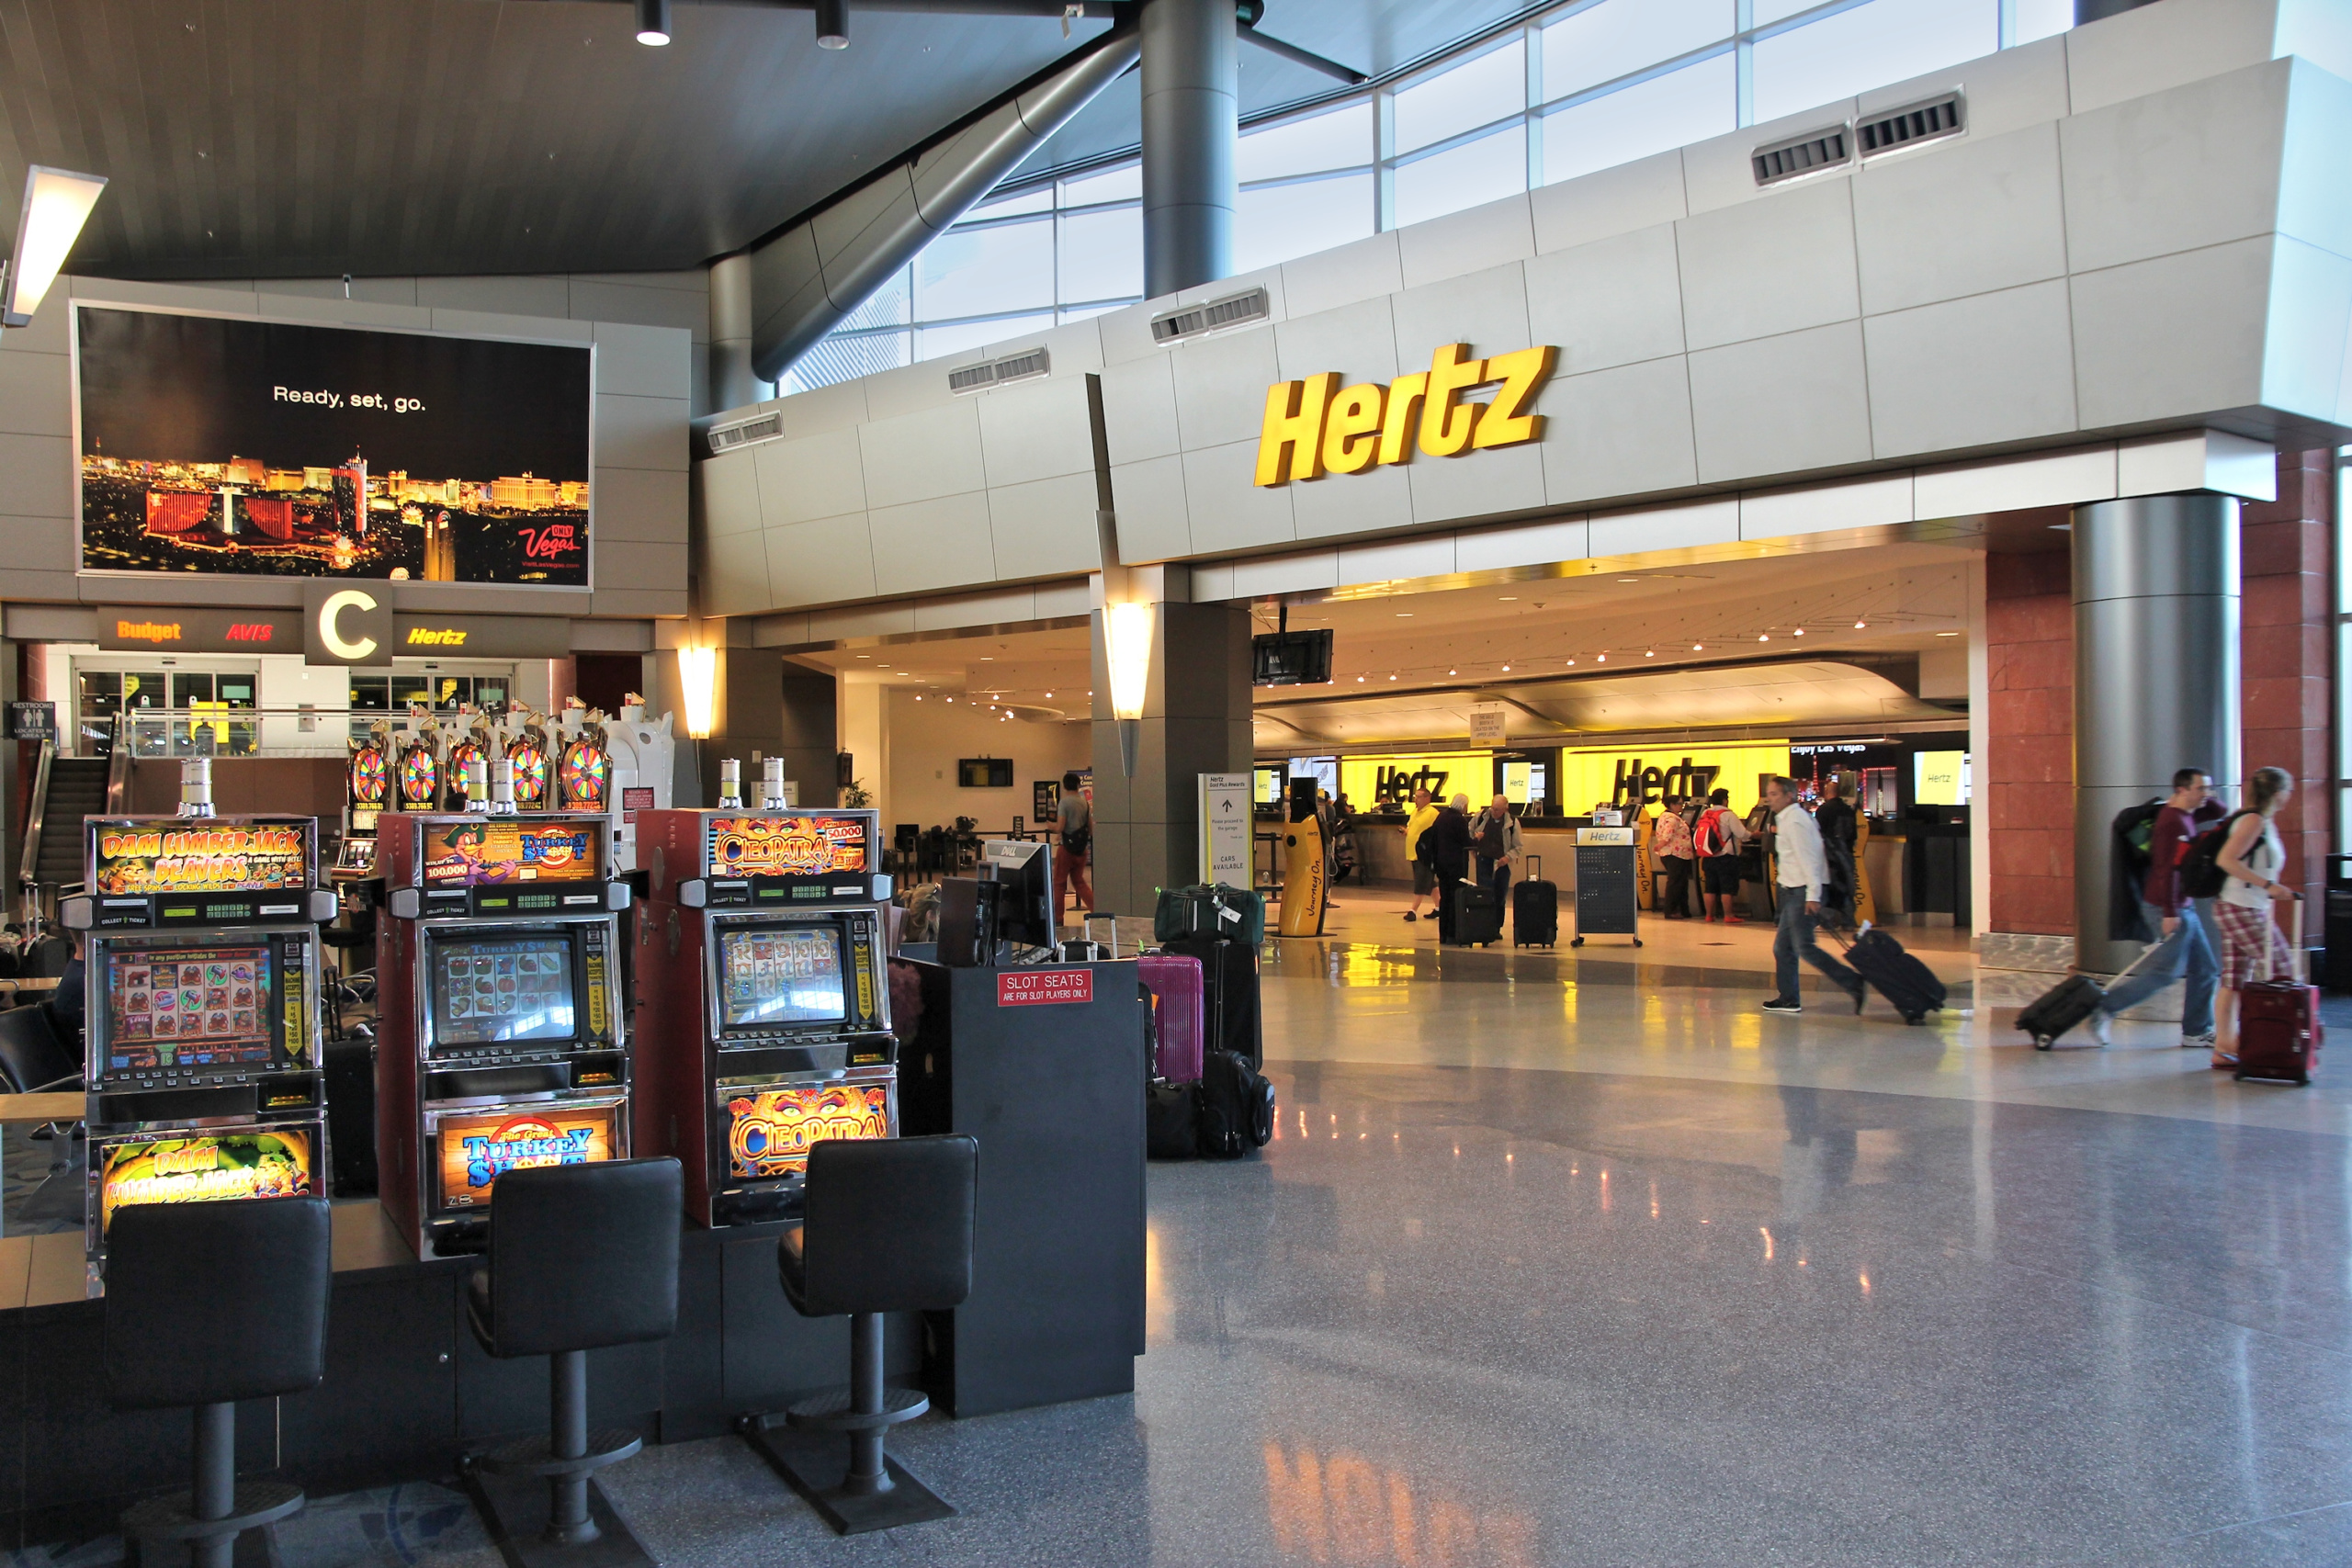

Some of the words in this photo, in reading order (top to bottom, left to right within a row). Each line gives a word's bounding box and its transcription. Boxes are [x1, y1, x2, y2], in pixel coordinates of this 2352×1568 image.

[274, 385, 345, 409] Ready,
[350, 393, 389, 412] set,
[394, 397, 426, 414] go.
[1253, 343, 1557, 489] Hertz
[553, 525, 574, 537] ONLY
[518, 526, 581, 559] Vegas
[521, 560, 580, 569] VisitLasVegas.com
[117, 621, 181, 644] Budget
[226, 624, 274, 641] AVIS
[318, 590, 379, 660] C
[407, 627, 468, 646] Hertz
[1791, 745, 1815, 755] Enjoy
[1817, 745, 1835, 753] Las
[1838, 744, 1866, 754] Vegas
[1374, 764, 1449, 803] Hertz
[1510, 779, 1524, 787] Hertz
[1612, 758, 1721, 807] Hertz
[1928, 773, 1951, 783] Hertz
[102, 832, 162, 859] DAM
[163, 830, 302, 859] LUMBERJACK
[520, 832, 589, 848] TURKEY
[1590, 831, 1620, 840] Hertz
[719, 833, 827, 866] CLEOPATRA
[1001, 846, 1017, 857] DELL
[153, 855, 249, 884] BEAVERS
[428, 864, 468, 878] 100,000
[144, 883, 162, 891] SPINS
[175, 883, 201, 891] LOCKING
[202, 882, 220, 890] WILDS
[1306, 875, 1322, 916] Journey
[470, 942, 525, 954] TURKEY
[1007, 976, 1038, 989] SLOT
[1045, 974, 1084, 987] SEATS
[1003, 993, 1014, 1001] ARE
[1016, 992, 1027, 1000] FOR
[1029, 991, 1044, 1000] SLOT
[1046, 989, 1070, 999] PLAYERS
[1073, 989, 1087, 998] ONLY
[462, 1127, 594, 1161] TURKEY
[501, 1131, 521, 1141] The
[524, 1129, 554, 1139] Great
[738, 1115, 879, 1162] CLEOPATRA
[153, 1145, 219, 1176] DAM
[105, 1166, 256, 1211] LUMBERJACK
